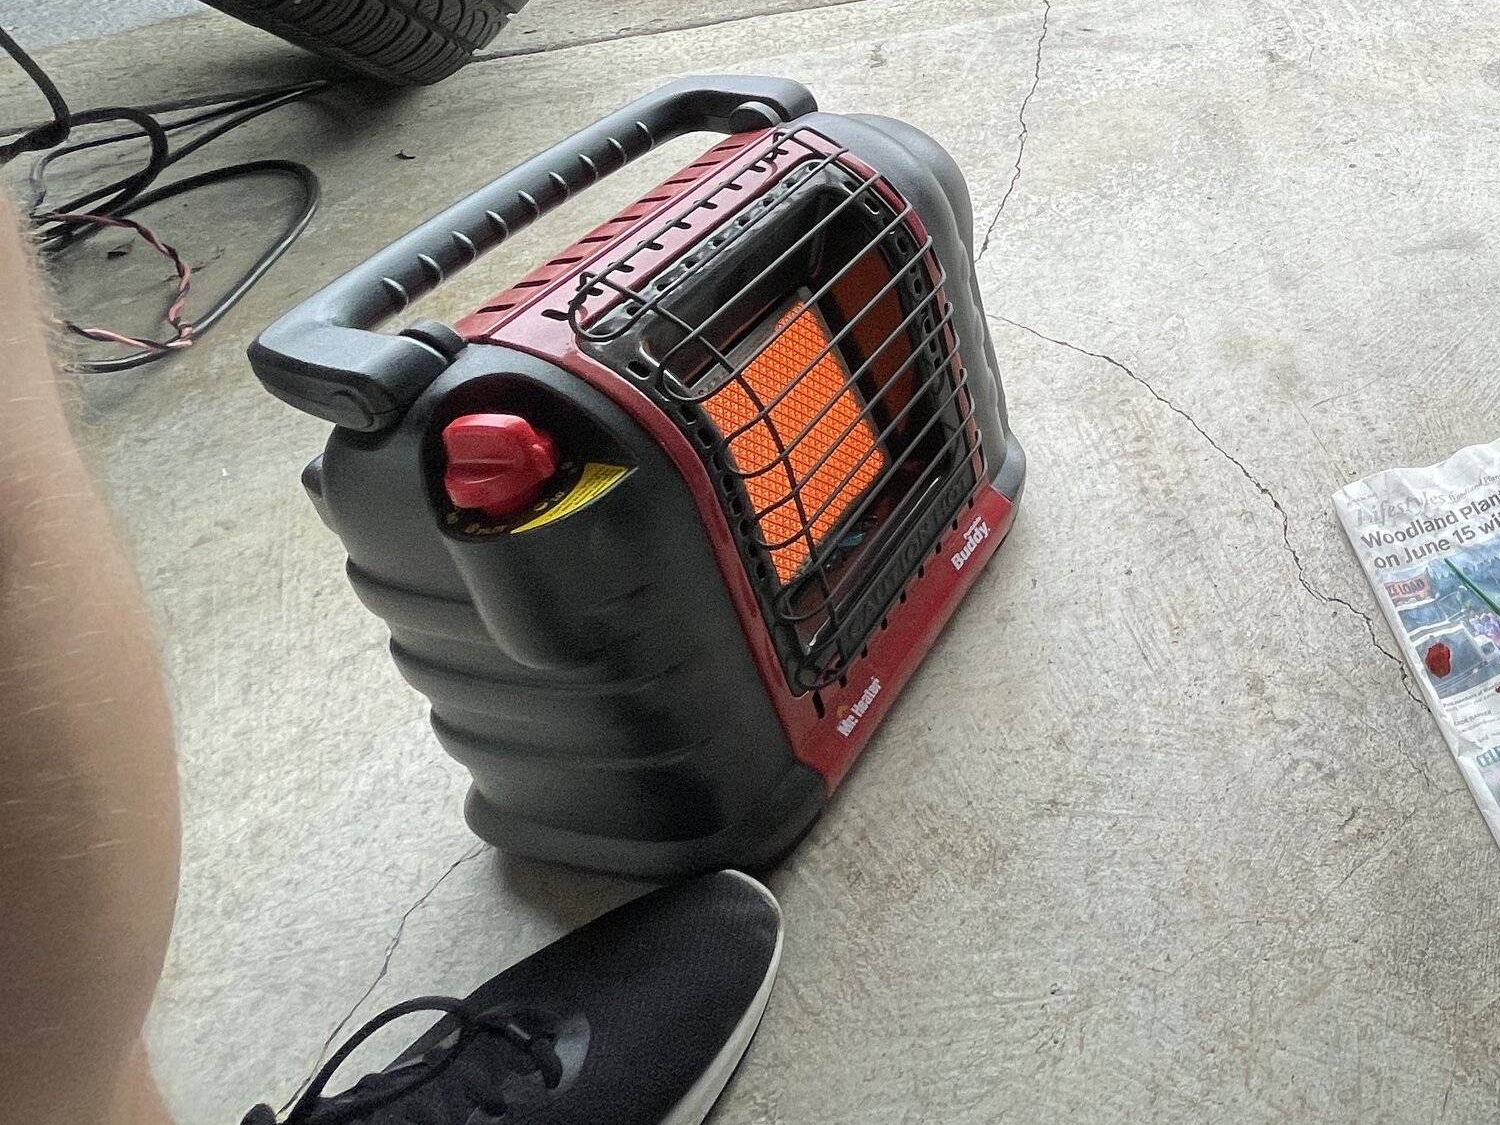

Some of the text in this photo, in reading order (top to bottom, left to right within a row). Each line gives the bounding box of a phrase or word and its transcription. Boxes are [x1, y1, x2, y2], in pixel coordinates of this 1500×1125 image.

[950, 521, 991, 570] Buddy
[1361, 508, 1458, 549] Woodland
[1374, 552, 1401, 569] on
[1405, 538, 1451, 564] June
[1452, 525, 1476, 544] 15
